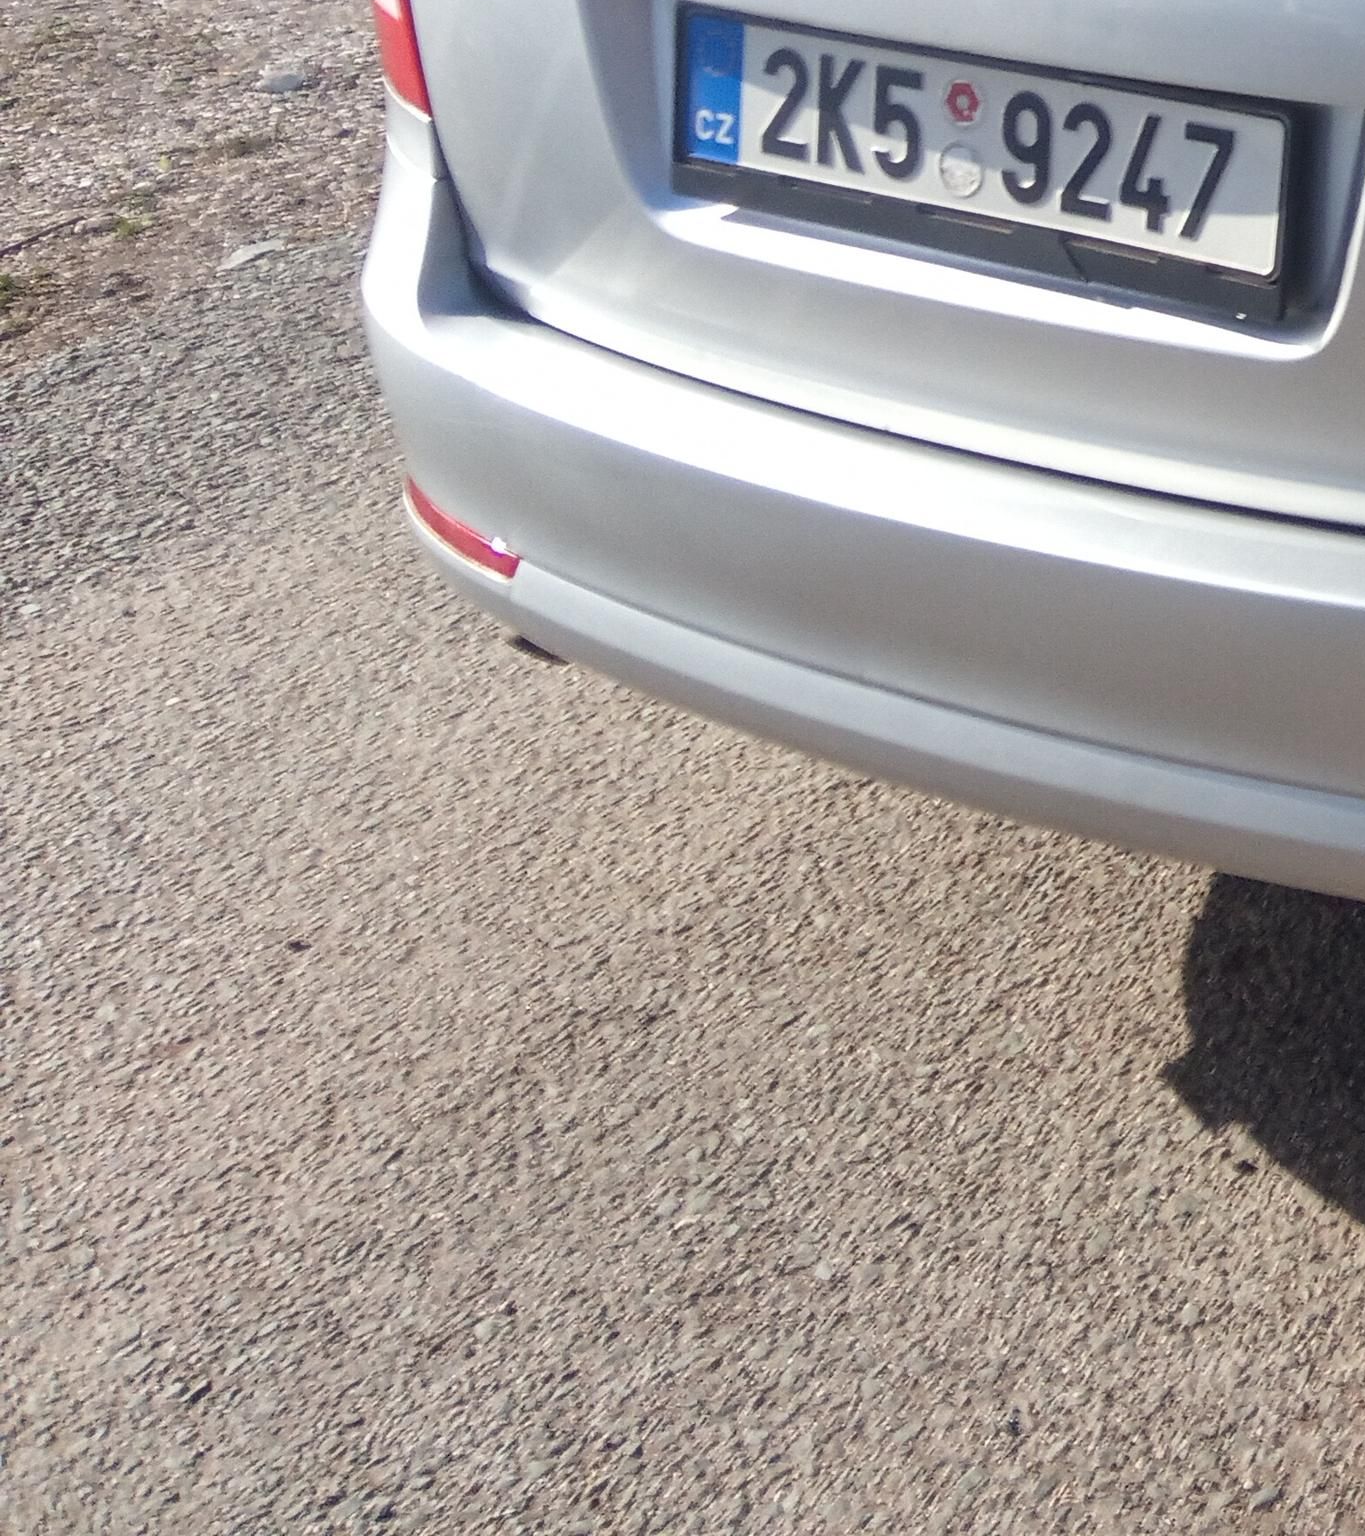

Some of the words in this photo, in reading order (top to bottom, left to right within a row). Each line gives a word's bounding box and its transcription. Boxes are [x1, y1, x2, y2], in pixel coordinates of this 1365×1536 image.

[695, 109, 734, 145] CZ
[760, 46, 925, 179] 2K5
[1001, 89, 1236, 241] 9247
